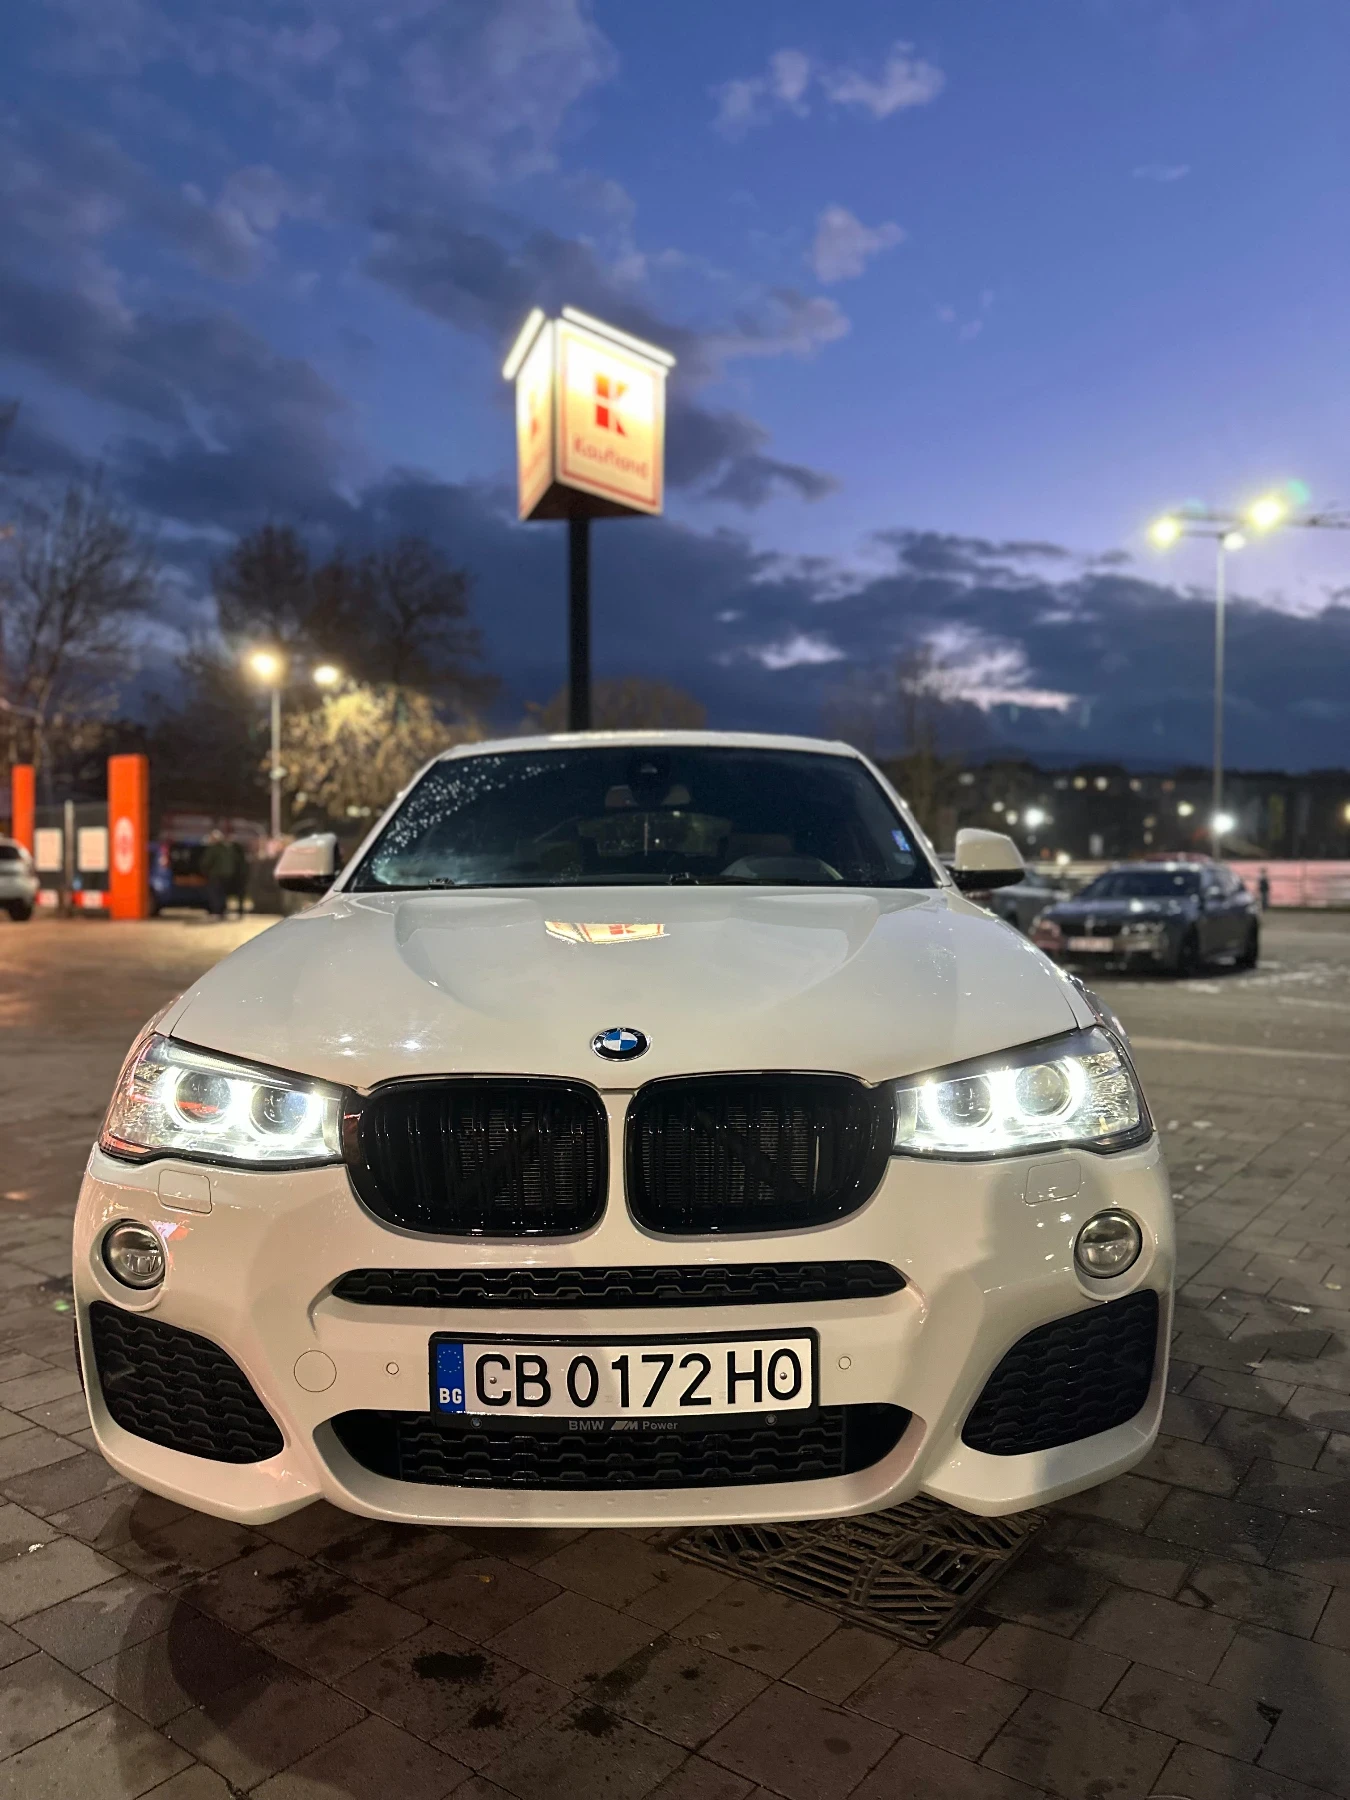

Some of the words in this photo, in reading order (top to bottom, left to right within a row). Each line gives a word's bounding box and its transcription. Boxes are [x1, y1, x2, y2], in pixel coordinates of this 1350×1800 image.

[475, 1353, 552, 1407] CB
[566, 1353, 712, 1408] 0172
[439, 1387, 463, 1405] BG
[568, 1420, 605, 1431] BMW
[642, 1420, 679, 1430] Power
